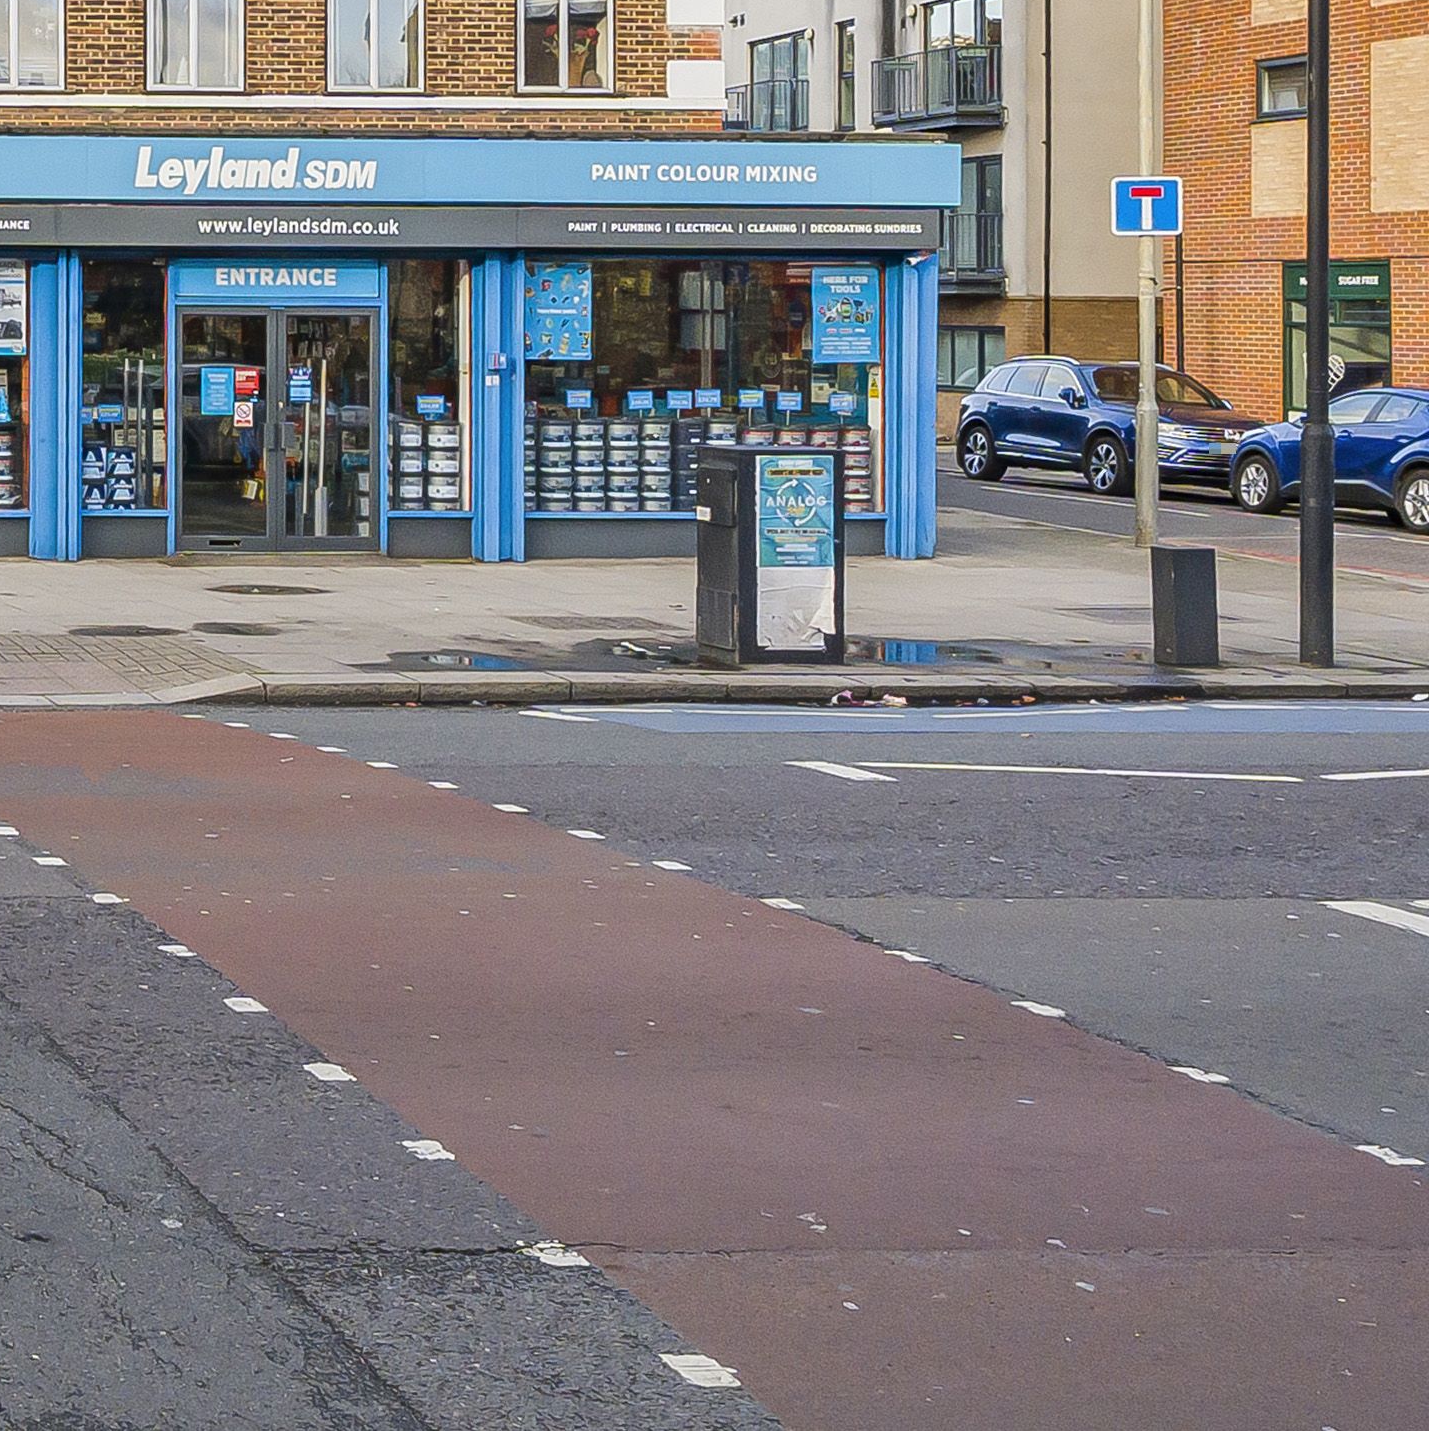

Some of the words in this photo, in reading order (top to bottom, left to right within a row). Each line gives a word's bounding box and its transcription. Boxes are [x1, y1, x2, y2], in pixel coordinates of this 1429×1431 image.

[134, 146, 300, 195] Leyland
[303, 160, 377, 189] SDM
[591, 163, 651, 182] PAINT
[656, 164, 740, 183] COLOUR
[745, 164, 818, 183] MIXING
[198, 216, 400, 237] www.leylandsdm.co.uk
[567, 221, 598, 233] PAINT
[610, 222, 662, 233] PLUMBING
[674, 222, 734, 234] ELECTRICAL
[746, 222, 798, 234] CLEANING
[809, 222, 873, 234] DECORATING
[874, 223, 923, 235] SUNDRIES
[215, 267, 337, 287] ENTRANCE
[830, 285, 861, 293] TOOLS
[766, 495, 828, 507] ANALOG
